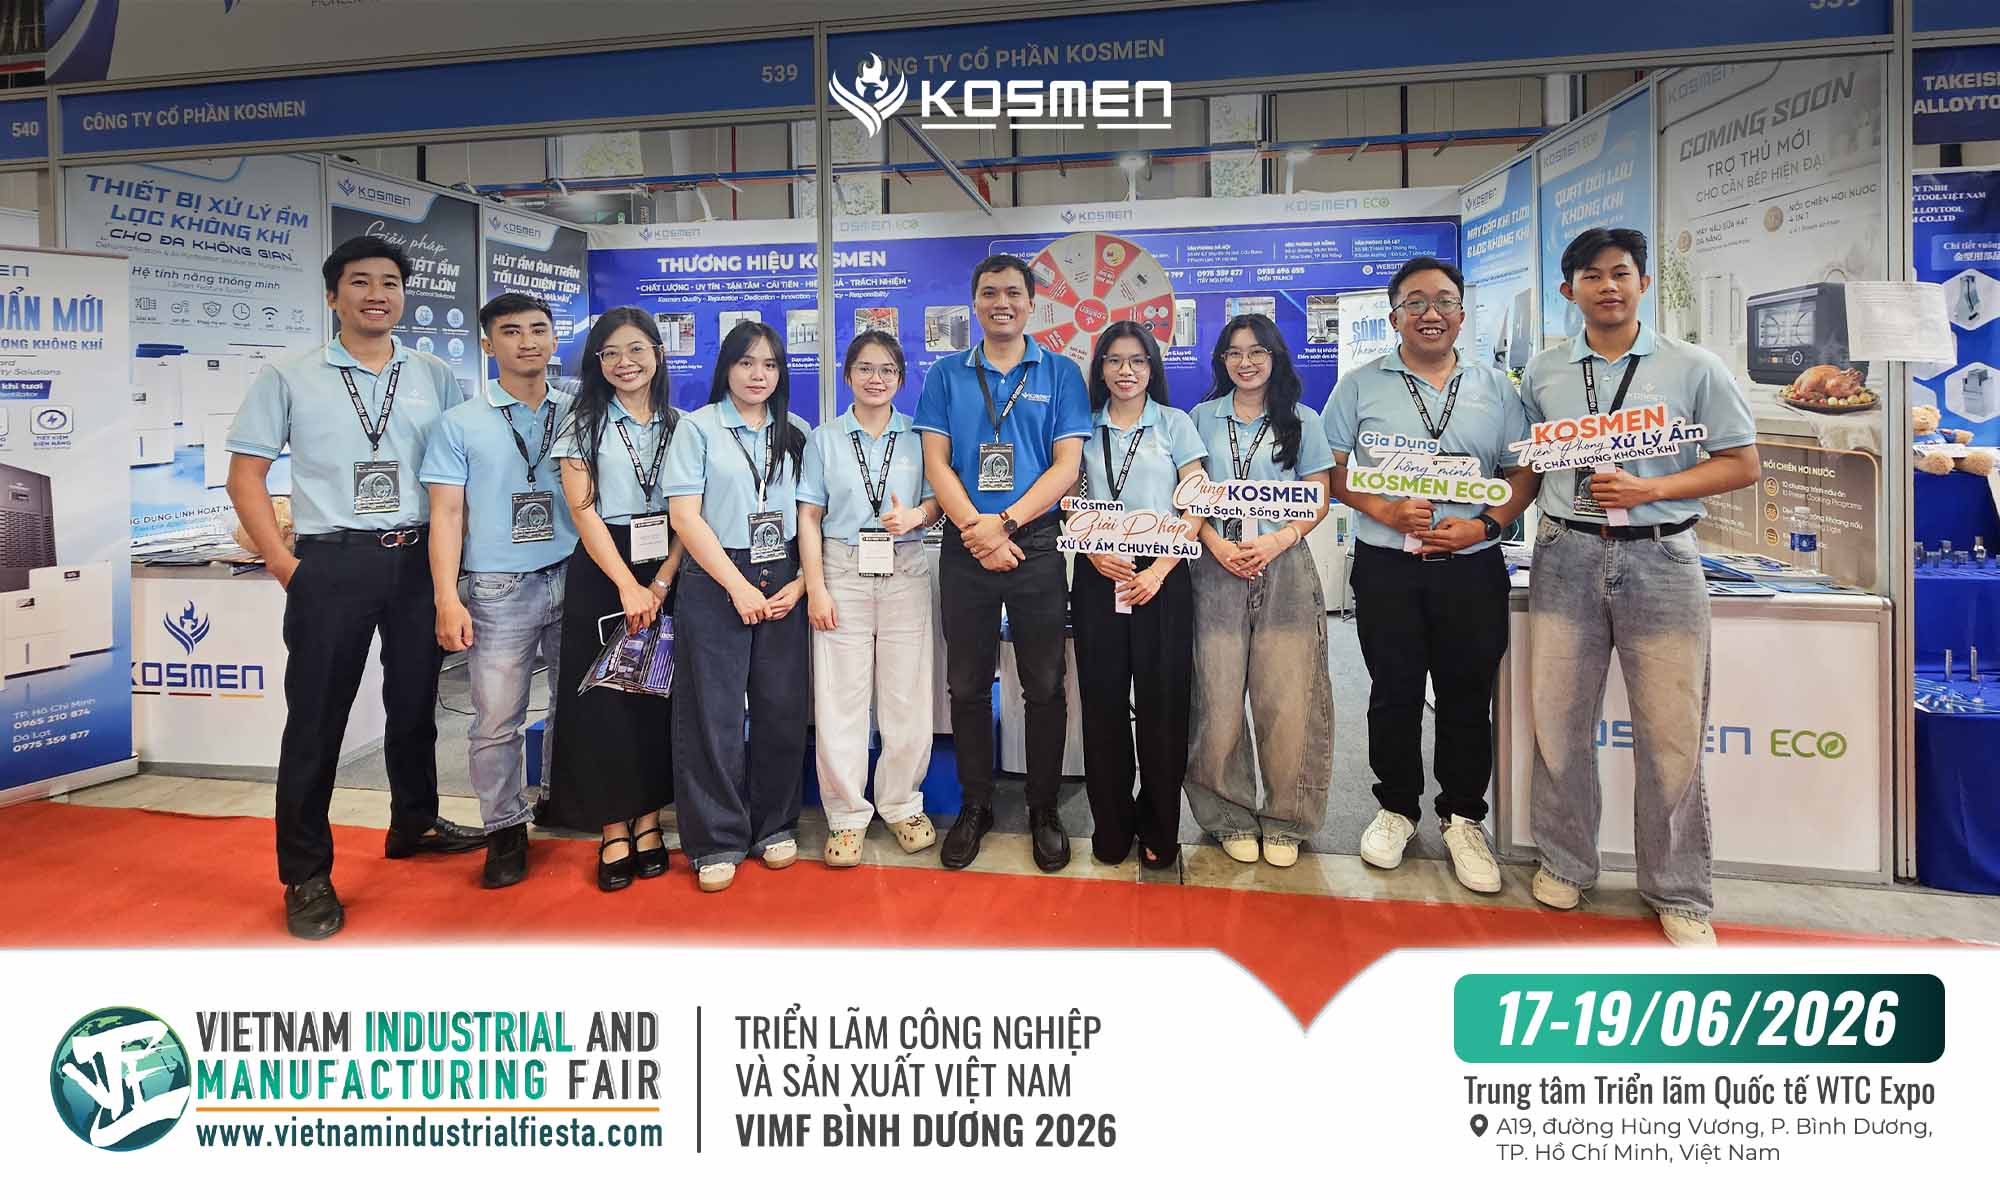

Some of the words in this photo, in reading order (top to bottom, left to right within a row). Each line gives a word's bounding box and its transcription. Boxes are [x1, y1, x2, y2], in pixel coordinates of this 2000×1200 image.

[924, 54, 952, 73] TY
[996, 42, 1058, 68] PHẦN
[1067, 38, 1164, 63] KOSMEN
[761, 64, 798, 82] 539
[83, 111, 128, 131] CÔNG
[131, 111, 153, 128] TY
[156, 105, 180, 127] CỔ
[183, 102, 230, 125] PHẦN
[234, 100, 305, 121] KOSMEN
[1680, 107, 1768, 162] COMING
[1772, 72, 1855, 127] SOON
[12, 120, 39, 137] 540
[1741, 140, 1770, 168] THỦ
[1777, 128, 1810, 153] MỚI
[86, 174, 171, 203] THIẾT
[176, 192, 202, 213] BỊ
[208, 197, 243, 216] XỬ
[246, 203, 271, 222] LÝ
[357, 186, 411, 207] KOSMEN
[1285, 199, 1357, 212] KOSMEN
[1363, 198, 1391, 208] ECO
[1696, 184, 1718, 203] CHO
[110, 204, 163, 227] LỌC
[170, 214, 251, 240] KHÔNG
[256, 228, 291, 246] KHÍ
[1078, 209, 1133, 221] KOSMEN
[502, 222, 541, 239] KOSMEN
[109, 228, 153, 243] CHO
[159, 234, 185, 247] ĐA
[192, 239, 252, 257] KHÔNG
[258, 248, 293, 262] GIAN
[657, 254, 742, 273] THƯƠNG
[747, 251, 794, 274] HIỆU
[132, 266, 150, 279] Hệ
[183, 271, 214, 286] năng
[255, 280, 281, 290] minh
[663, 283, 690, 293] LƯỢNG
[850, 276, 877, 286] TRÁCH
[879, 276, 907, 286] NHIỆM
[53, 294, 104, 333] MỚI
[1352, 315, 1386, 341] SỐNG
[32, 336, 78, 350] KHÔNG
[81, 338, 103, 351] KHÍ
[1535, 406, 1664, 446] KOSMEN
[1610, 433, 1637, 450] Xử
[1642, 429, 1662, 449] Lý
[1668, 420, 1704, 442] Ẩm
[1362, 433, 1390, 448] Gia
[1395, 436, 1438, 456] Dụng
[1534, 462, 1543, 471] &
[1574, 454, 1612, 468] LƯỢNG
[1614, 447, 1653, 462] KHÔNG
[1657, 444, 1678, 455] KHÍ
[1176, 474, 1227, 507] Cùng
[1228, 485, 1319, 504] KOSMEN
[1352, 471, 1449, 497] KOSMEN
[1455, 481, 1507, 502] ECO
[174, 511, 195, 520] LINH
[1060, 499, 1124, 512] #Kosmen
[1189, 503, 1211, 515] Thở
[1213, 505, 1246, 519] Sạch,
[1249, 506, 1280, 520] Sống
[1283, 508, 1315, 519] Xanh
[1122, 513, 1188, 542] Pháp
[1060, 535, 1076, 550] XỬ
[1078, 538, 1092, 552] LÝ
[1095, 536, 1114, 552] ẨM
[1117, 541, 1170, 556] CHUYÊN
[1172, 542, 1199, 556] SÂU
[13, 716, 45, 730] 0965
[47, 712, 68, 724] 210
[70, 708, 91, 720] 874
[13, 740, 44, 753] 0975
[45, 735, 69, 747] 359
[70, 730, 91, 742] 877
[1770, 729, 1847, 759] ECO
